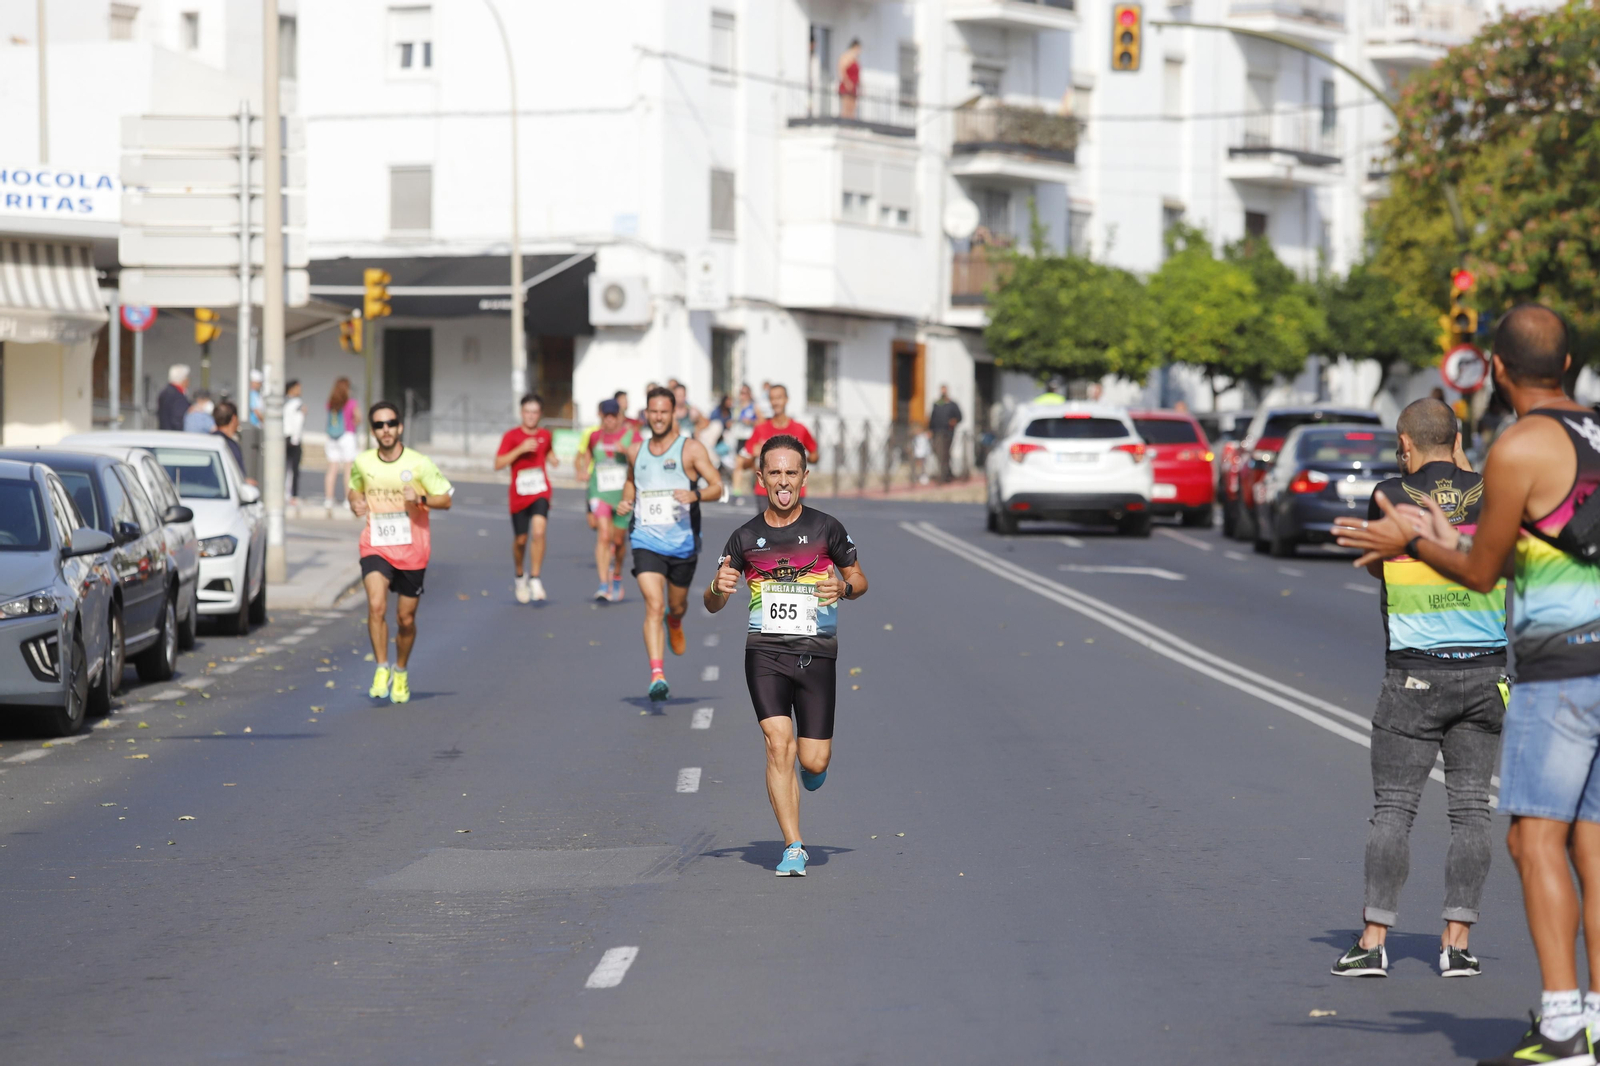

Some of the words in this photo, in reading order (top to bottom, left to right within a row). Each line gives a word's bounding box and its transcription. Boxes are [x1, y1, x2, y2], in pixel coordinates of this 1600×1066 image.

[0, 193, 93, 213] RITAS
[649, 504, 662, 515] 66
[377, 525, 396, 537] 369
[771, 584, 789, 593] VUELTA
[790, 585, 795, 593] A
[796, 585, 815, 594] HUELVA
[1428, 592, 1471, 604] IBHOLA
[770, 602, 797, 620] 655
